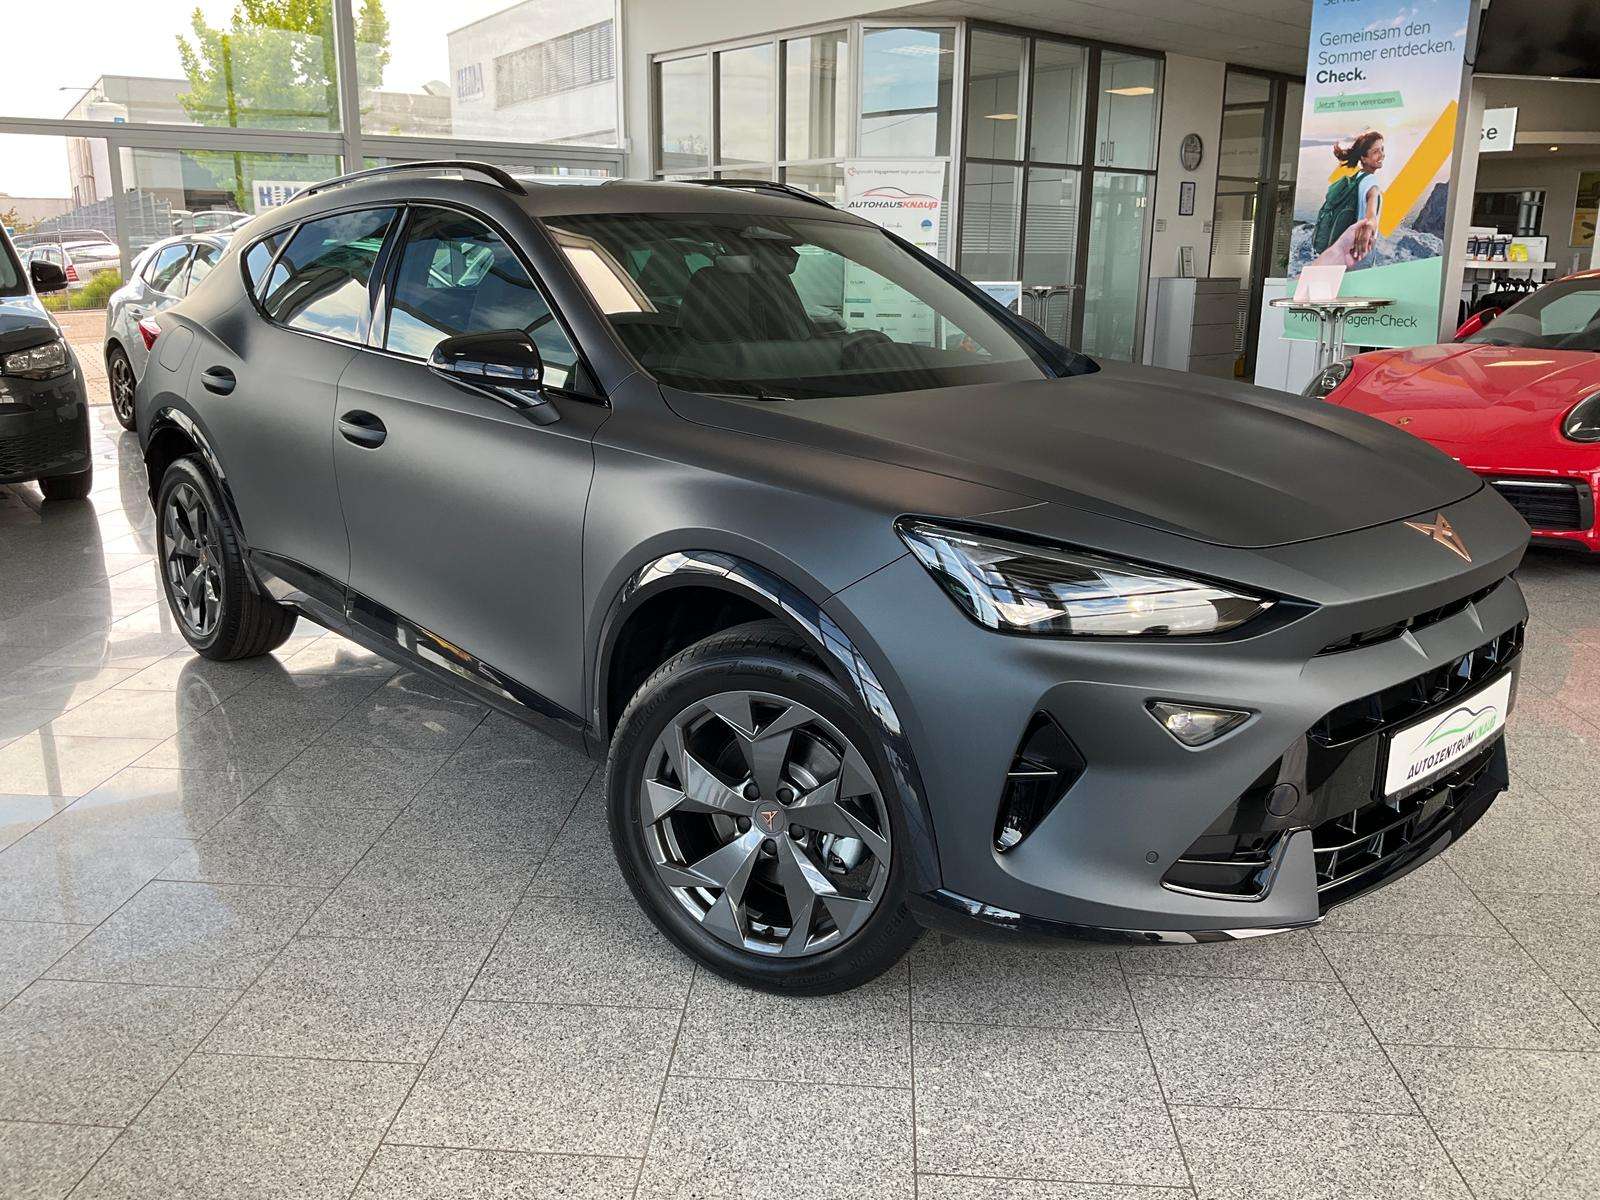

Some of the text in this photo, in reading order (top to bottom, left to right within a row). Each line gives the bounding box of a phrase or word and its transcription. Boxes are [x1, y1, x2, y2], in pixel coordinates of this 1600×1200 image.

[1320, 21, 1431, 47] Gemeinsam den
[1318, 39, 1456, 66] Sommer entdecken.
[1316, 67, 1367, 84] Check.
